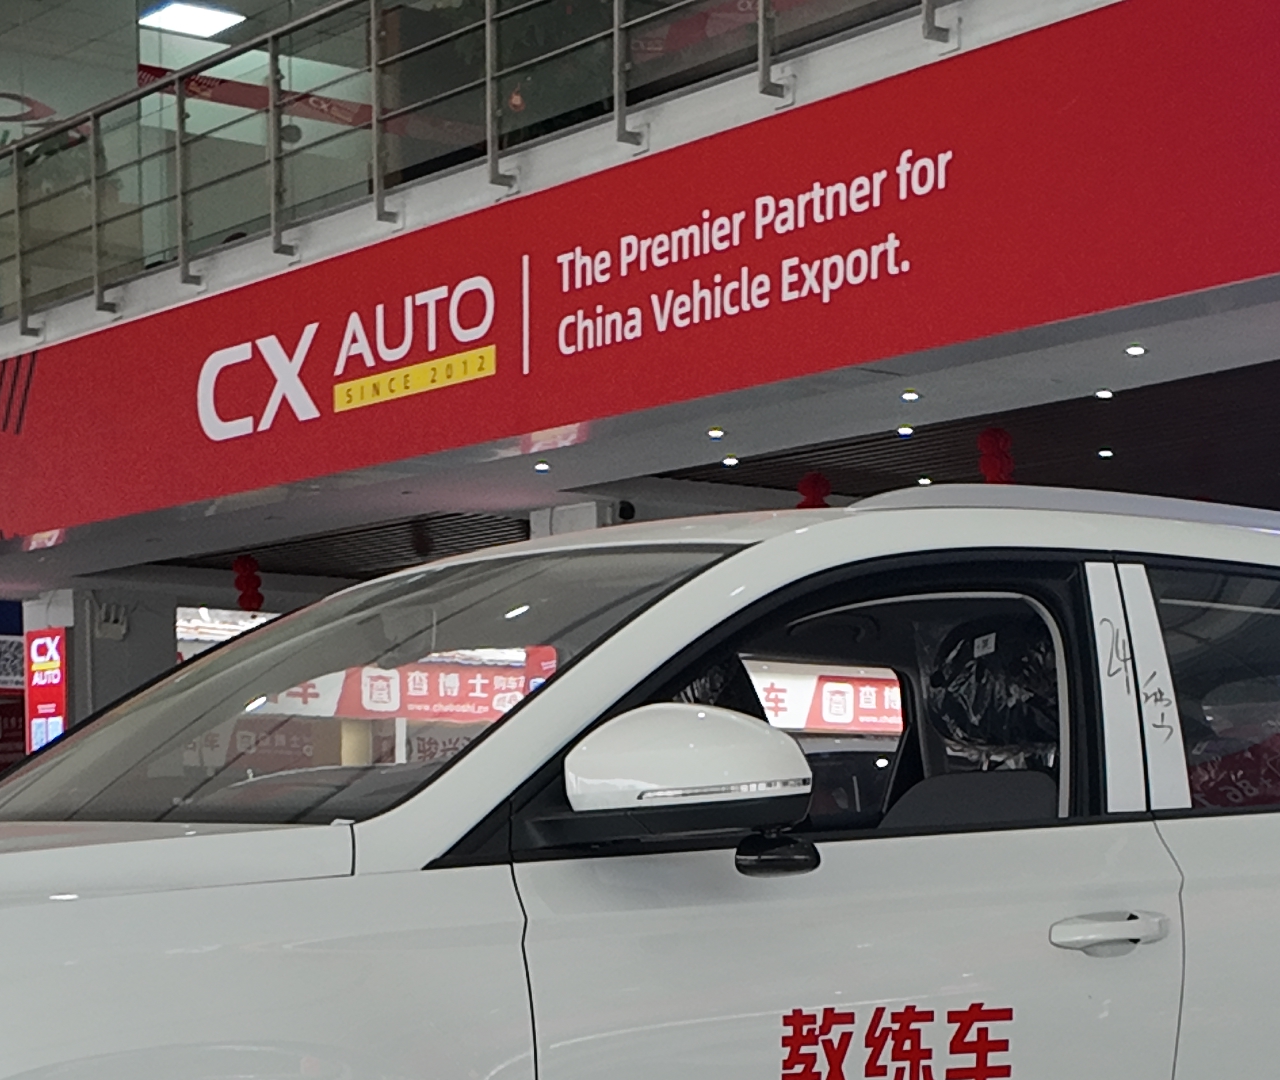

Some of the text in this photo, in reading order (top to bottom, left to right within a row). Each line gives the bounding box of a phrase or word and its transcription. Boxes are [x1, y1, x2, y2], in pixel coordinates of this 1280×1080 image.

[556, 149, 953, 292] The Premier Partner for
[558, 232, 911, 355] China Vehicle Export.
[197, 276, 495, 441] CX AUTO
[345, 355, 486, 404] SINCE 2012
[30, 636, 61, 663] CX
[32, 669, 61, 686] AUTO
[407, 671, 489, 698] 查博士
[763, 682, 787, 717] 车
